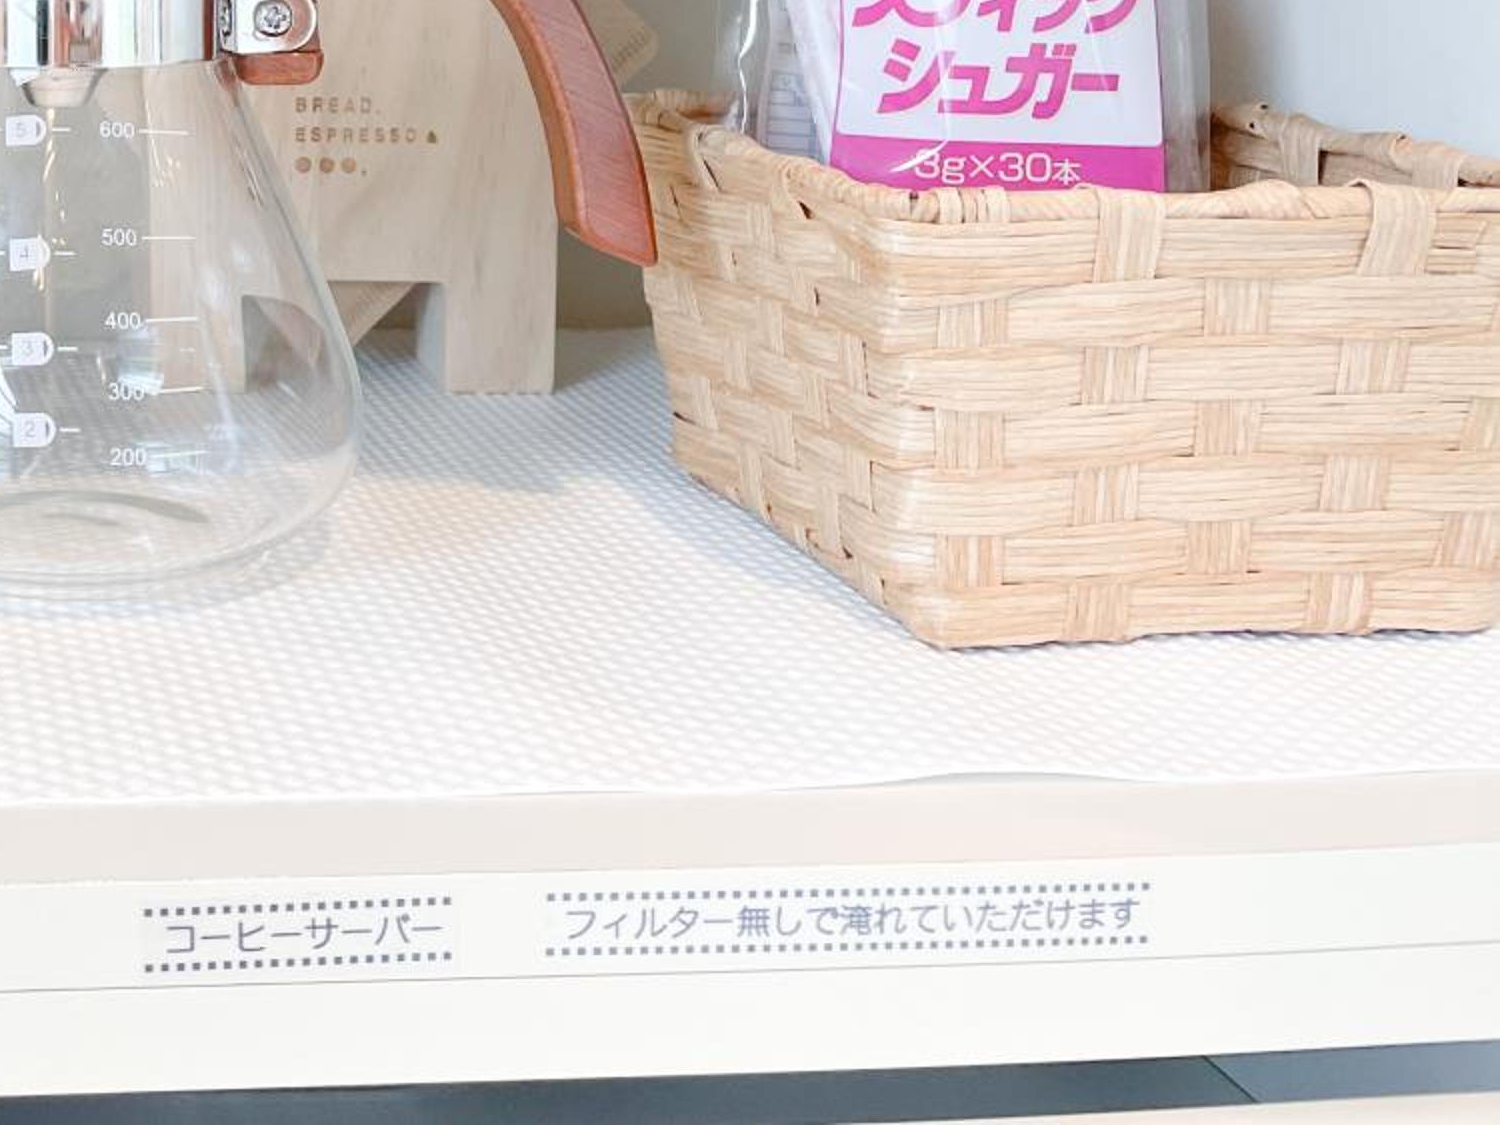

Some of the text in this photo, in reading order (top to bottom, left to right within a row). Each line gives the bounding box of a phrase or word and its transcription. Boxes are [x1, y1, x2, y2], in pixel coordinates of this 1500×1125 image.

[877, 36, 1121, 120] シュガー
[100, 122, 135, 139] 600
[295, 126, 417, 144] ESPRESSO
[102, 229, 137, 246] 500
[105, 312, 141, 330] 400
[108, 382, 146, 401] 300
[110, 447, 147, 466] 200
[566, 896, 1142, 941] フィルター無しで淹れていただけます
